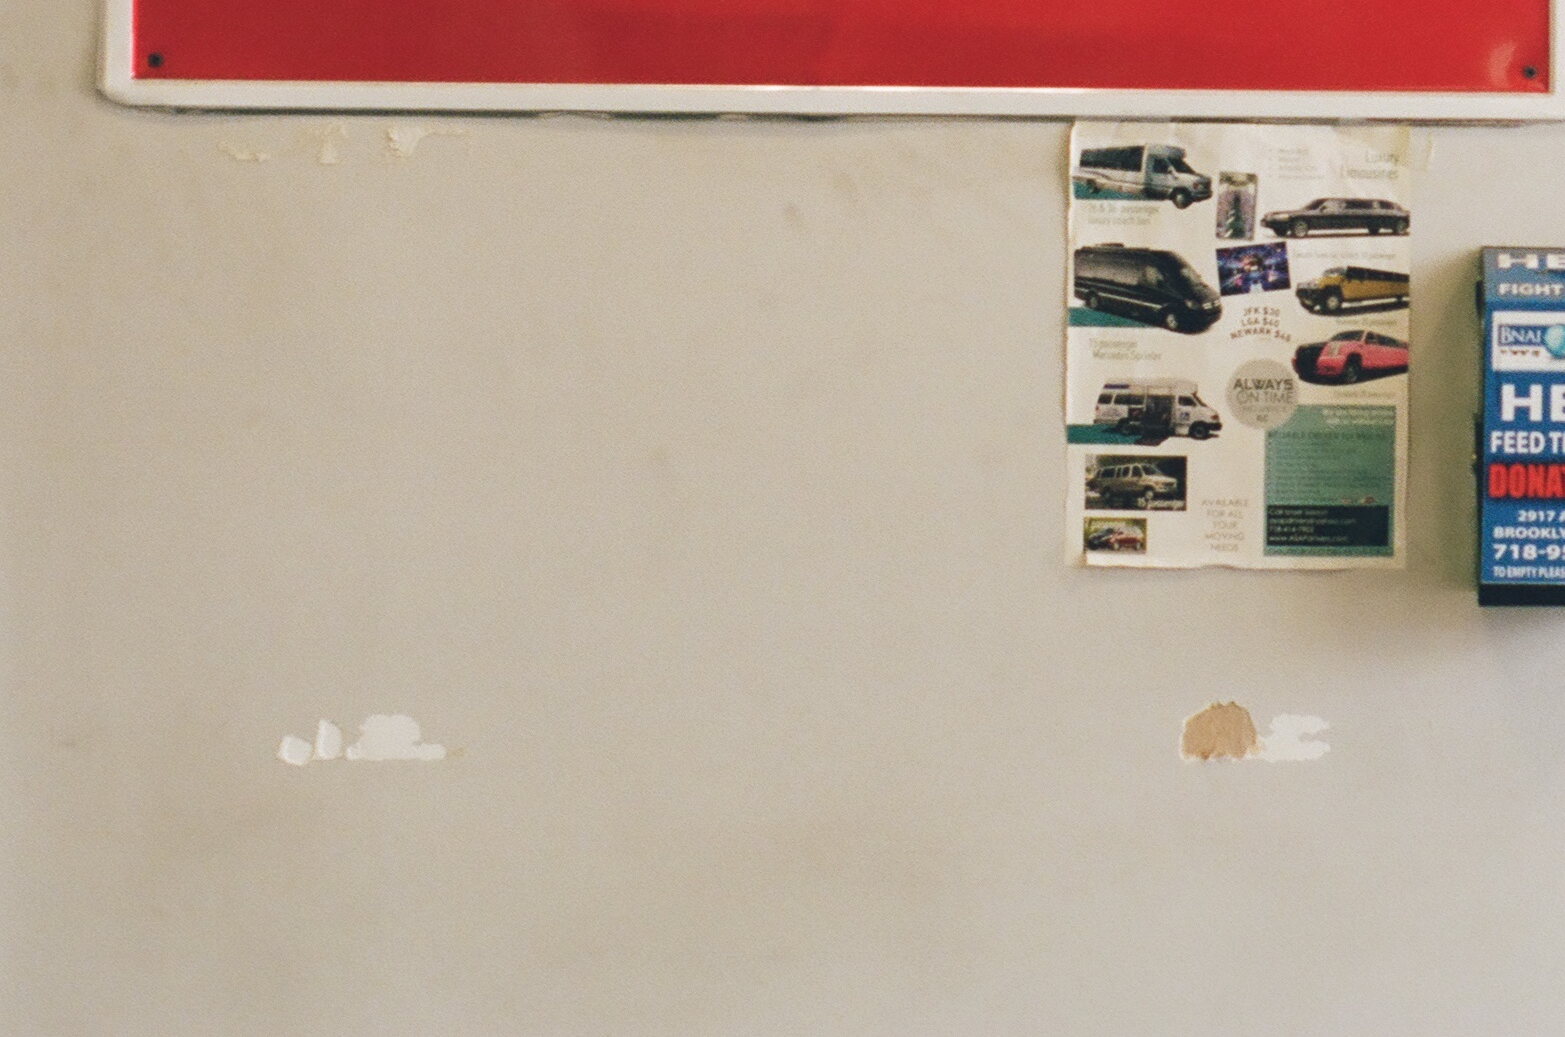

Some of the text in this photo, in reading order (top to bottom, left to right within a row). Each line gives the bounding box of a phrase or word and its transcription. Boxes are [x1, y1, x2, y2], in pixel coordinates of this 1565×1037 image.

[1498, 282, 1564, 297] FIGHT
[1233, 378, 1293, 390] ALWAYS
[1490, 431, 1545, 454] FEED
[1518, 509, 1556, 523] 2917
[1507, 565, 1538, 578] EMPTY
